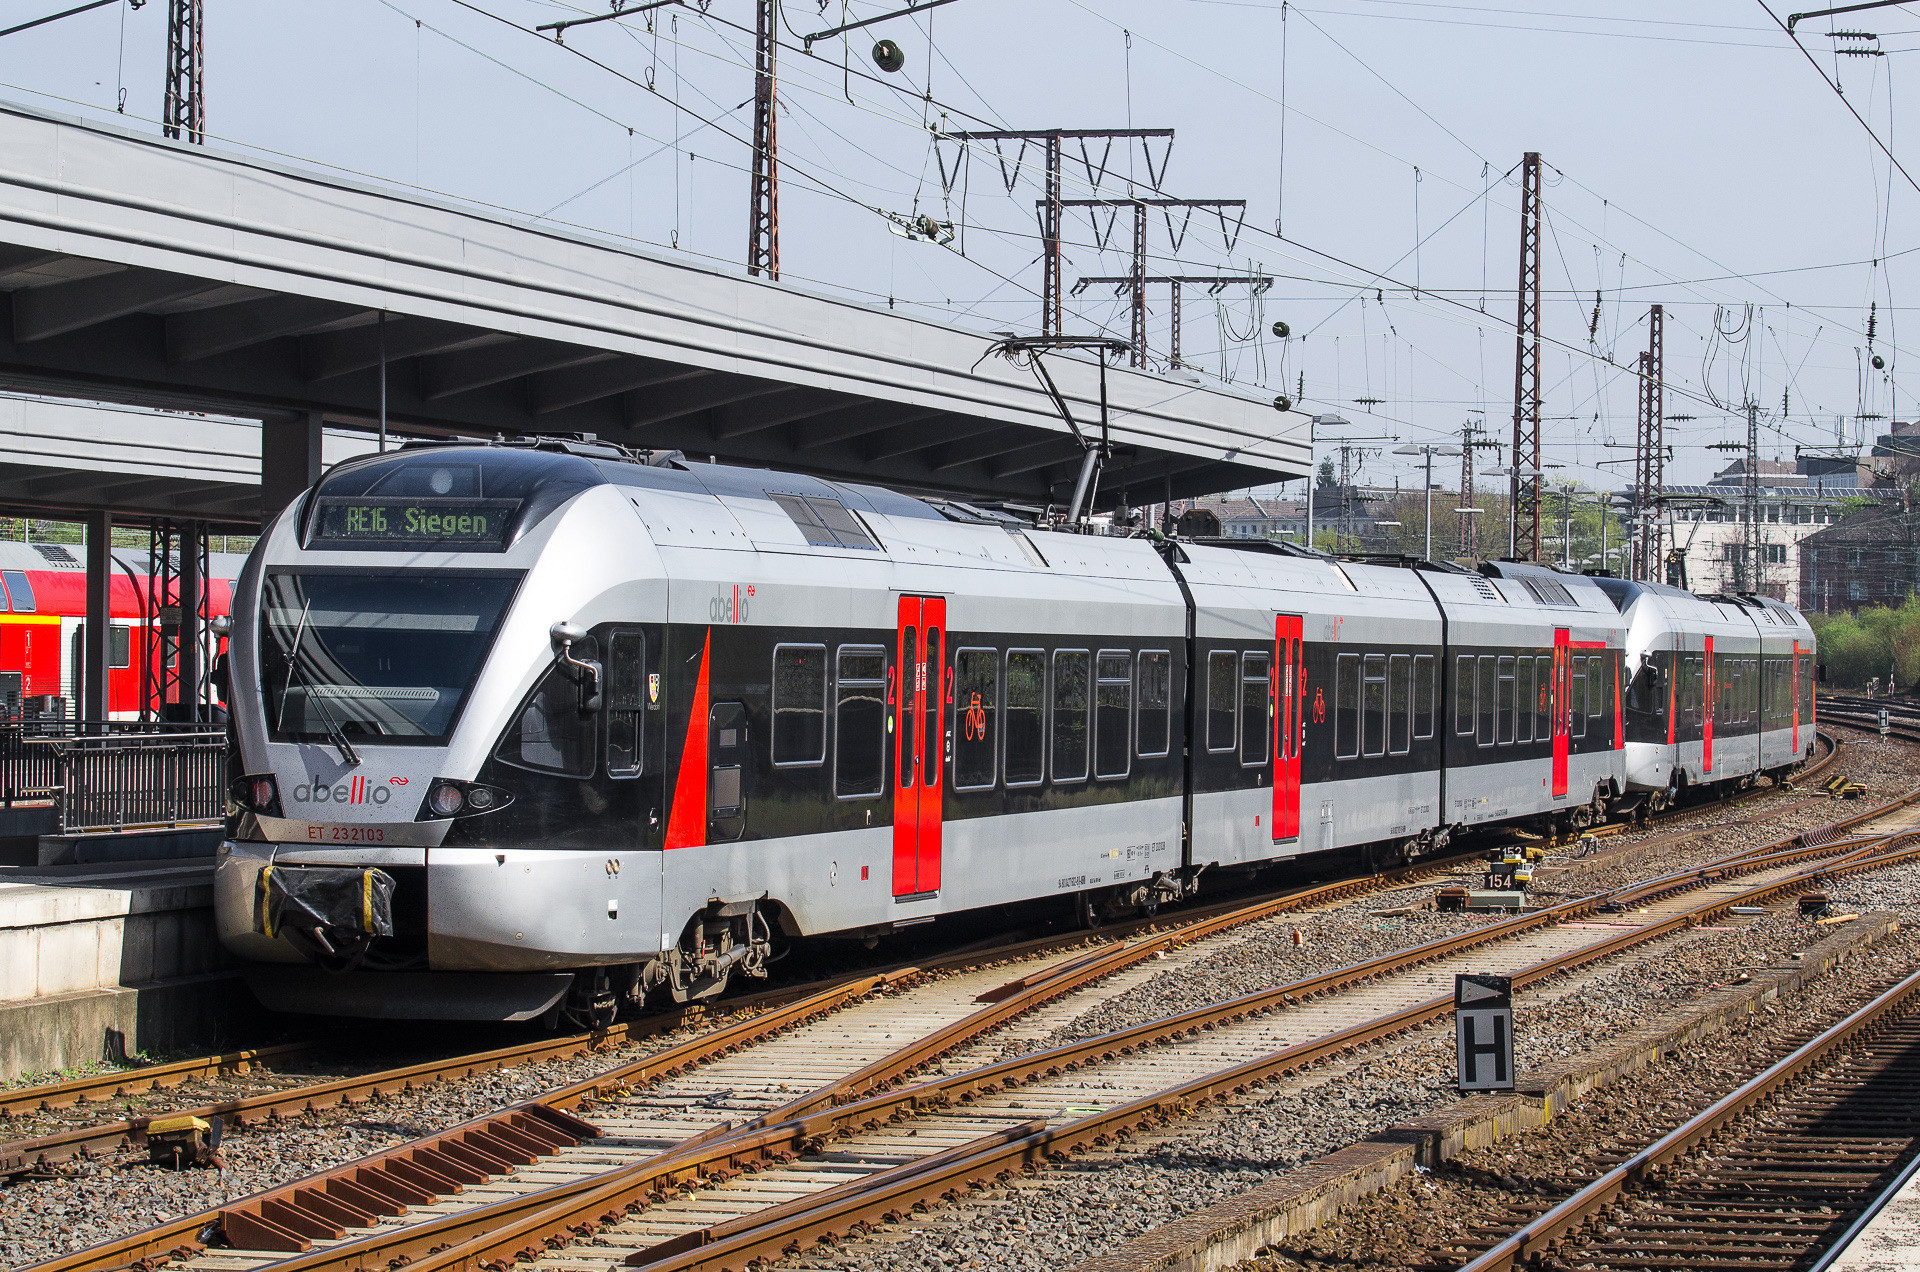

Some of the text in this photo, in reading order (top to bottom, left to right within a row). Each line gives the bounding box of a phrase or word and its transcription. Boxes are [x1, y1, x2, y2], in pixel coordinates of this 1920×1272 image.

[347, 507, 487, 536] RE16 Siegen
[710, 583, 749, 624] abellio
[887, 666, 896, 705] 2
[946, 666, 954, 704] 2
[1270, 667, 1275, 696] 2
[1302, 667, 1308, 697] 2
[293, 774, 391, 805] abellio
[308, 826, 384, 842] ET 232103
[1502, 846, 1522, 856] 152
[1488, 874, 1512, 888] 154
[1463, 1015, 1507, 1083] H
